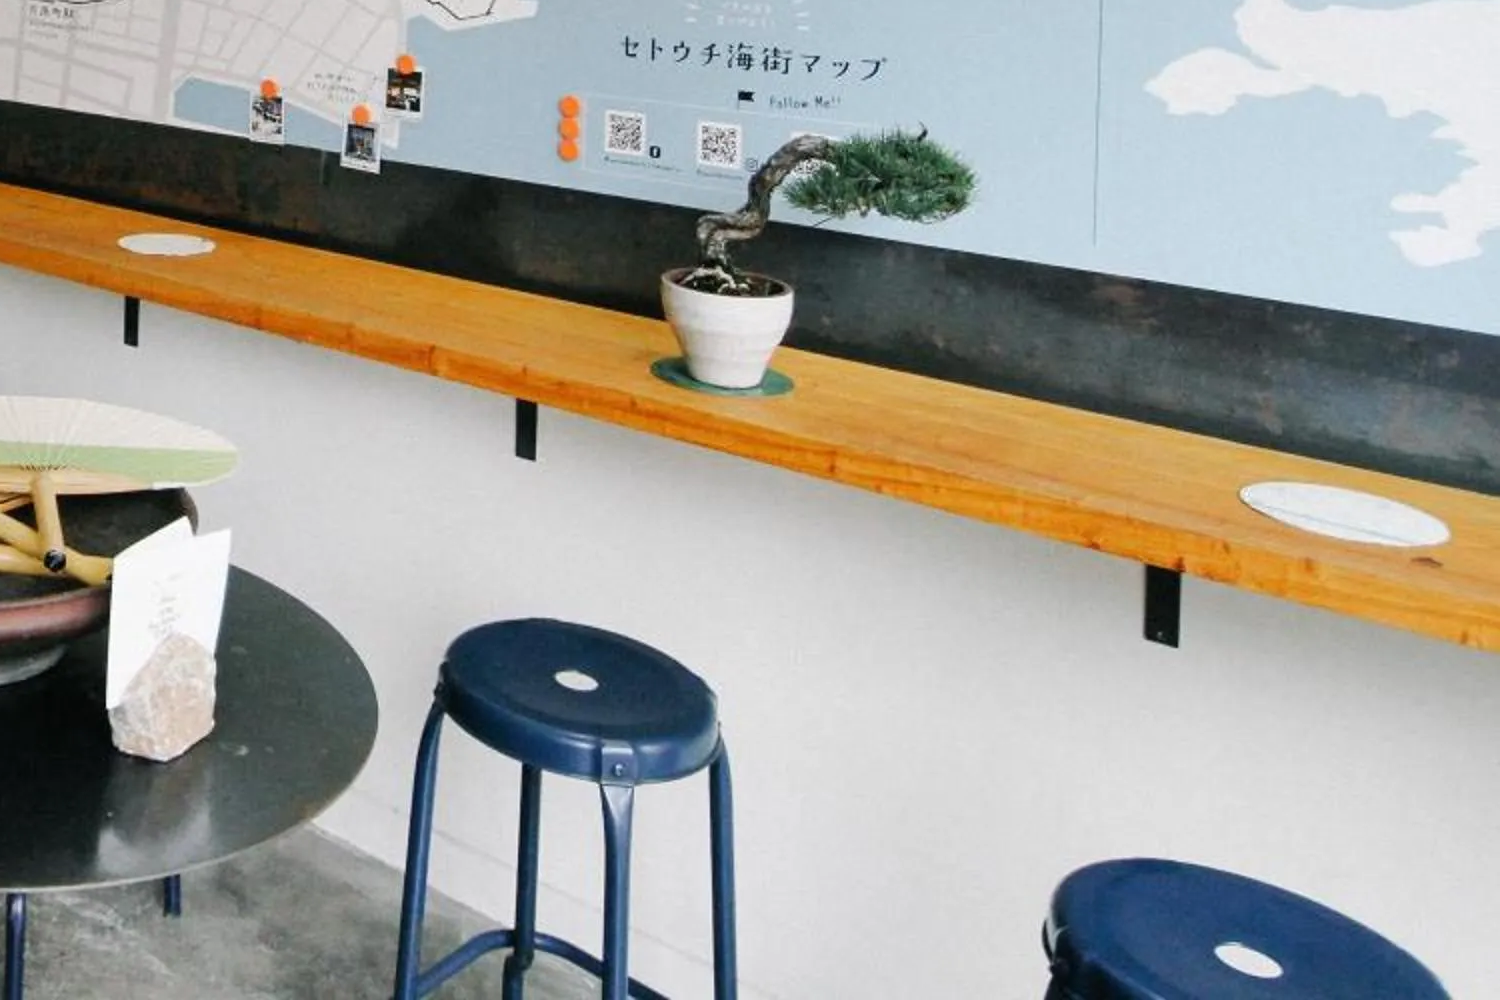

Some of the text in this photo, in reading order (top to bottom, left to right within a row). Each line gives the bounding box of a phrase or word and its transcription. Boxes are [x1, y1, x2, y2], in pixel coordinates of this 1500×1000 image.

[621, 35, 888, 81] セトウチ海街マップ
[769, 94, 809, 109] Follow
